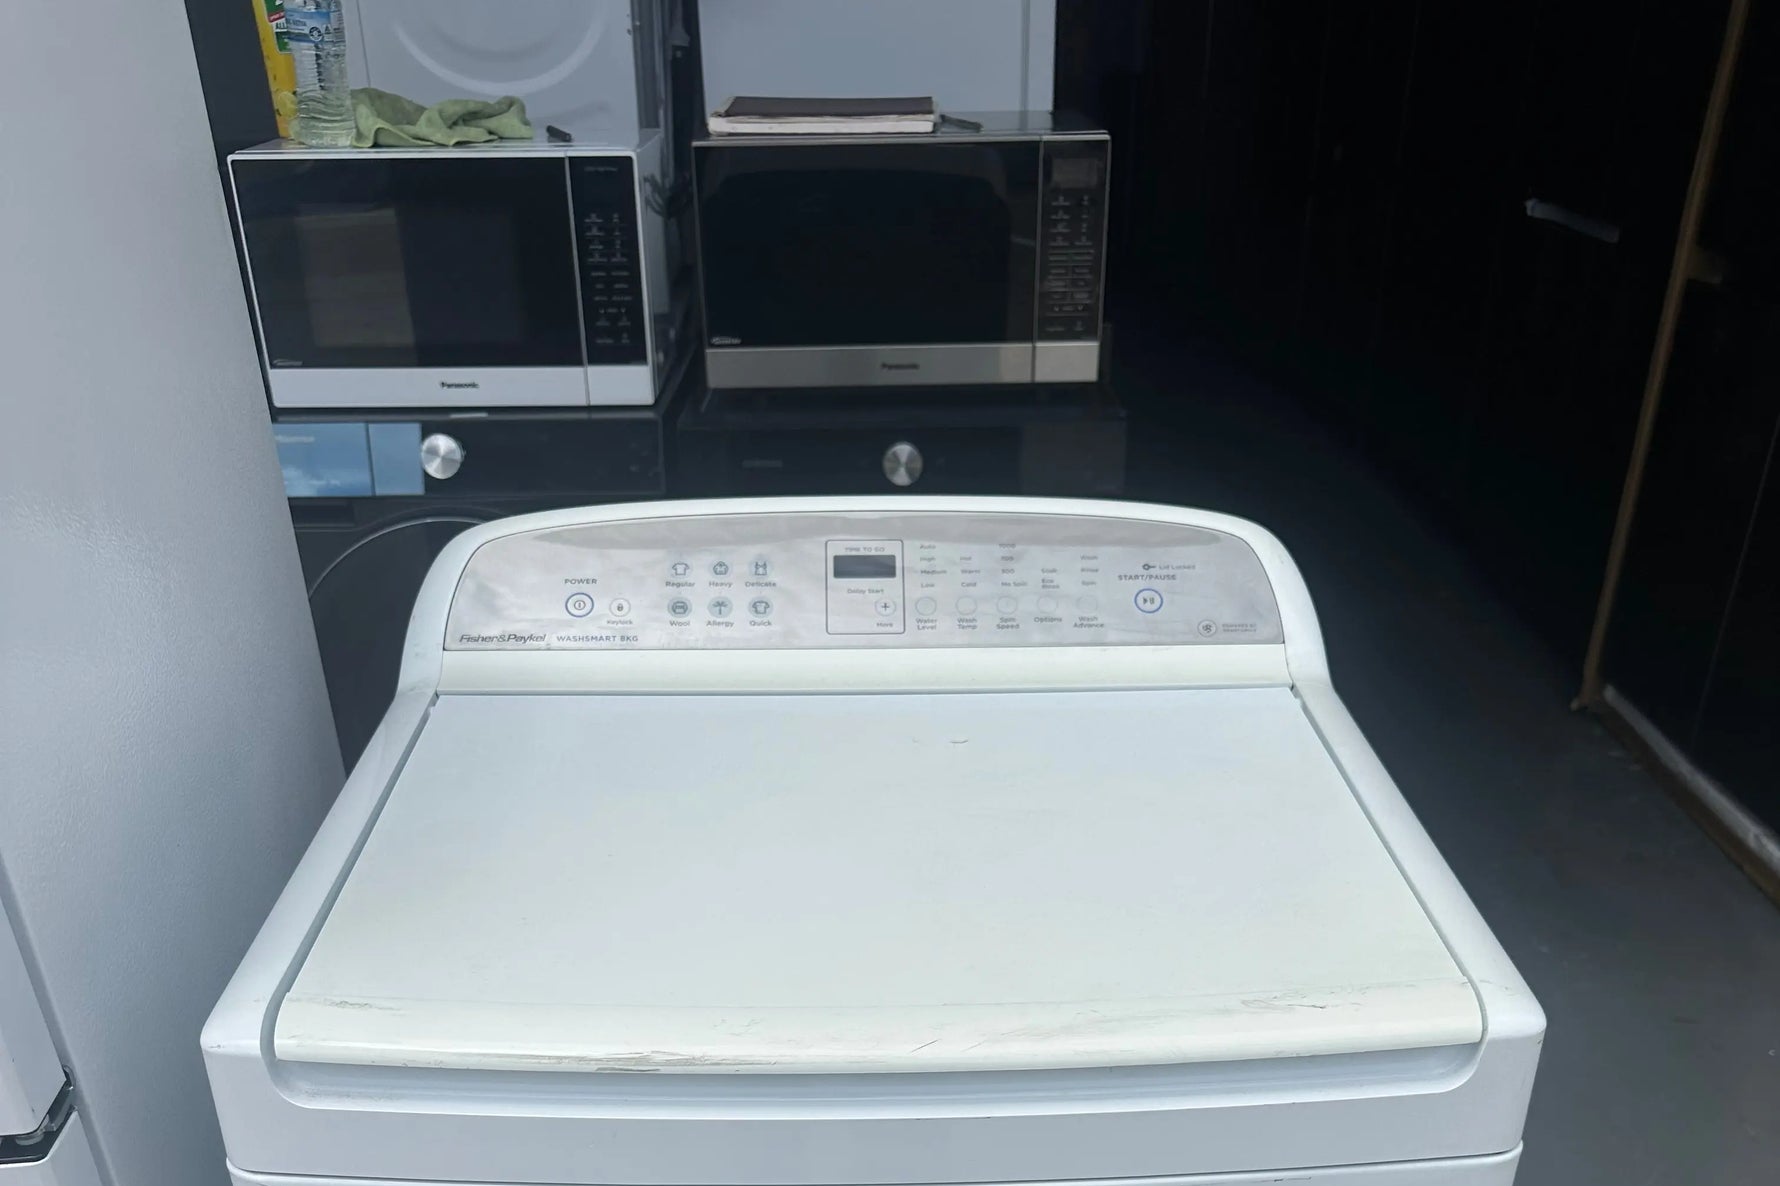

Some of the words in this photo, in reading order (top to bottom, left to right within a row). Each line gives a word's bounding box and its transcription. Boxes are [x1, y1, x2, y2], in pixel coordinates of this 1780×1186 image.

[441, 381, 480, 389] Panasonic
[706, 620, 735, 628] Allergy
[459, 633, 547, 644] Fisher&Paykel
